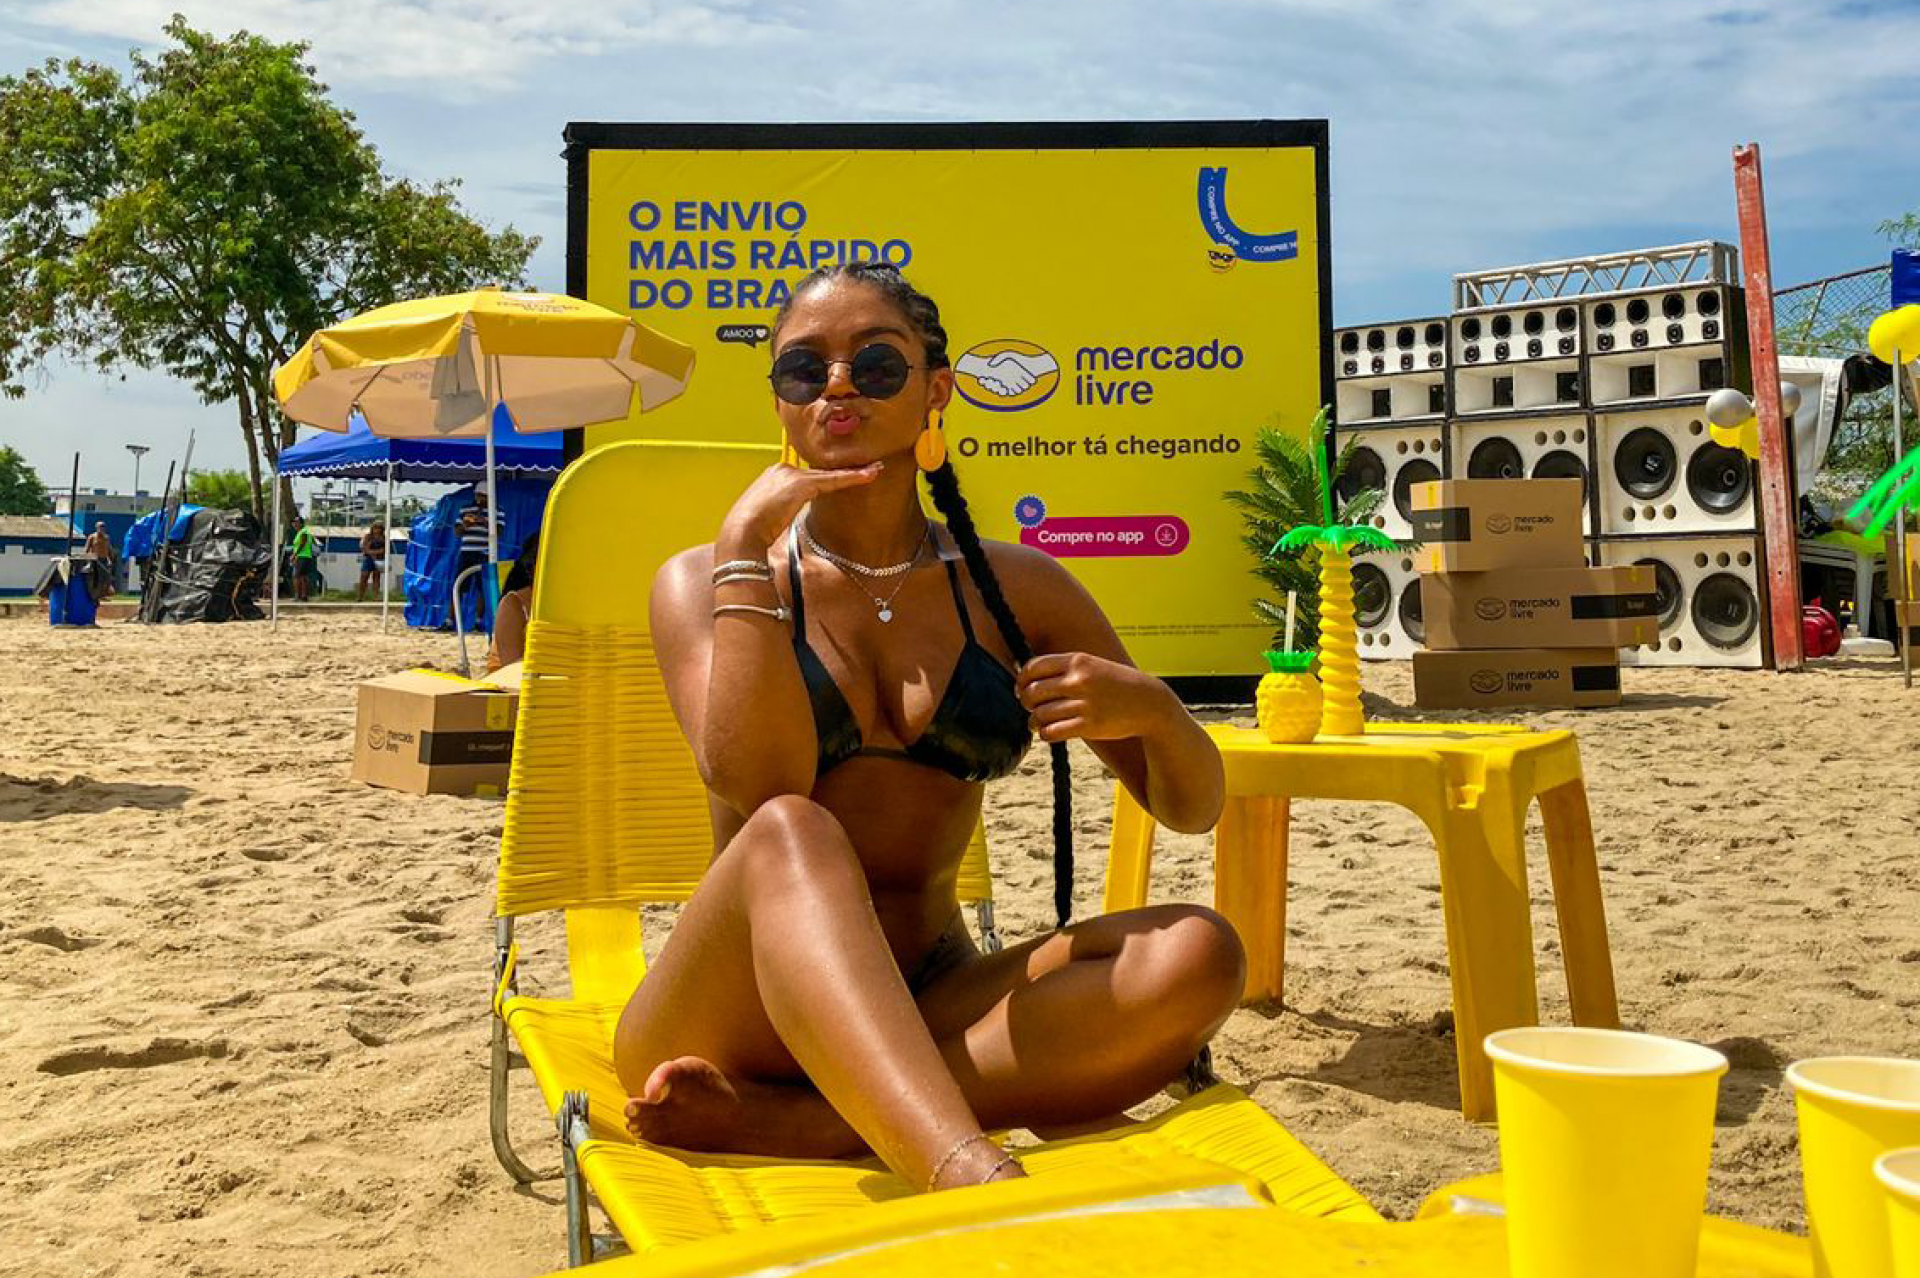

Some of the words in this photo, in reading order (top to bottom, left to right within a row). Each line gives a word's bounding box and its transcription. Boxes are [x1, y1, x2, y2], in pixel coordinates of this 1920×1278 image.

[628, 201, 661, 232] O
[674, 201, 808, 232] ENVIO
[629, 239, 736, 270] MAIS
[750, 232, 913, 270] RÁPIDO
[629, 279, 693, 310] DO
[706, 279, 793, 310] BRA
[1075, 339, 1244, 371] mercado
[1075, 374, 1154, 406] livre
[958, 436, 979, 457] O
[987, 435, 1076, 457] melhor
[1083, 434, 1108, 456] tá
[1115, 434, 1241, 460] chegando
[1513, 514, 1554, 524] mercado
[1513, 524, 1534, 532] livre
[1037, 530, 1094, 545] Compre
[1097, 531, 1115, 542] no
[1117, 531, 1145, 545] app
[1509, 597, 1560, 608] mercado
[1511, 609, 1534, 619] livre
[1506, 668, 1559, 680] mercado
[1506, 681, 1532, 692] livre
